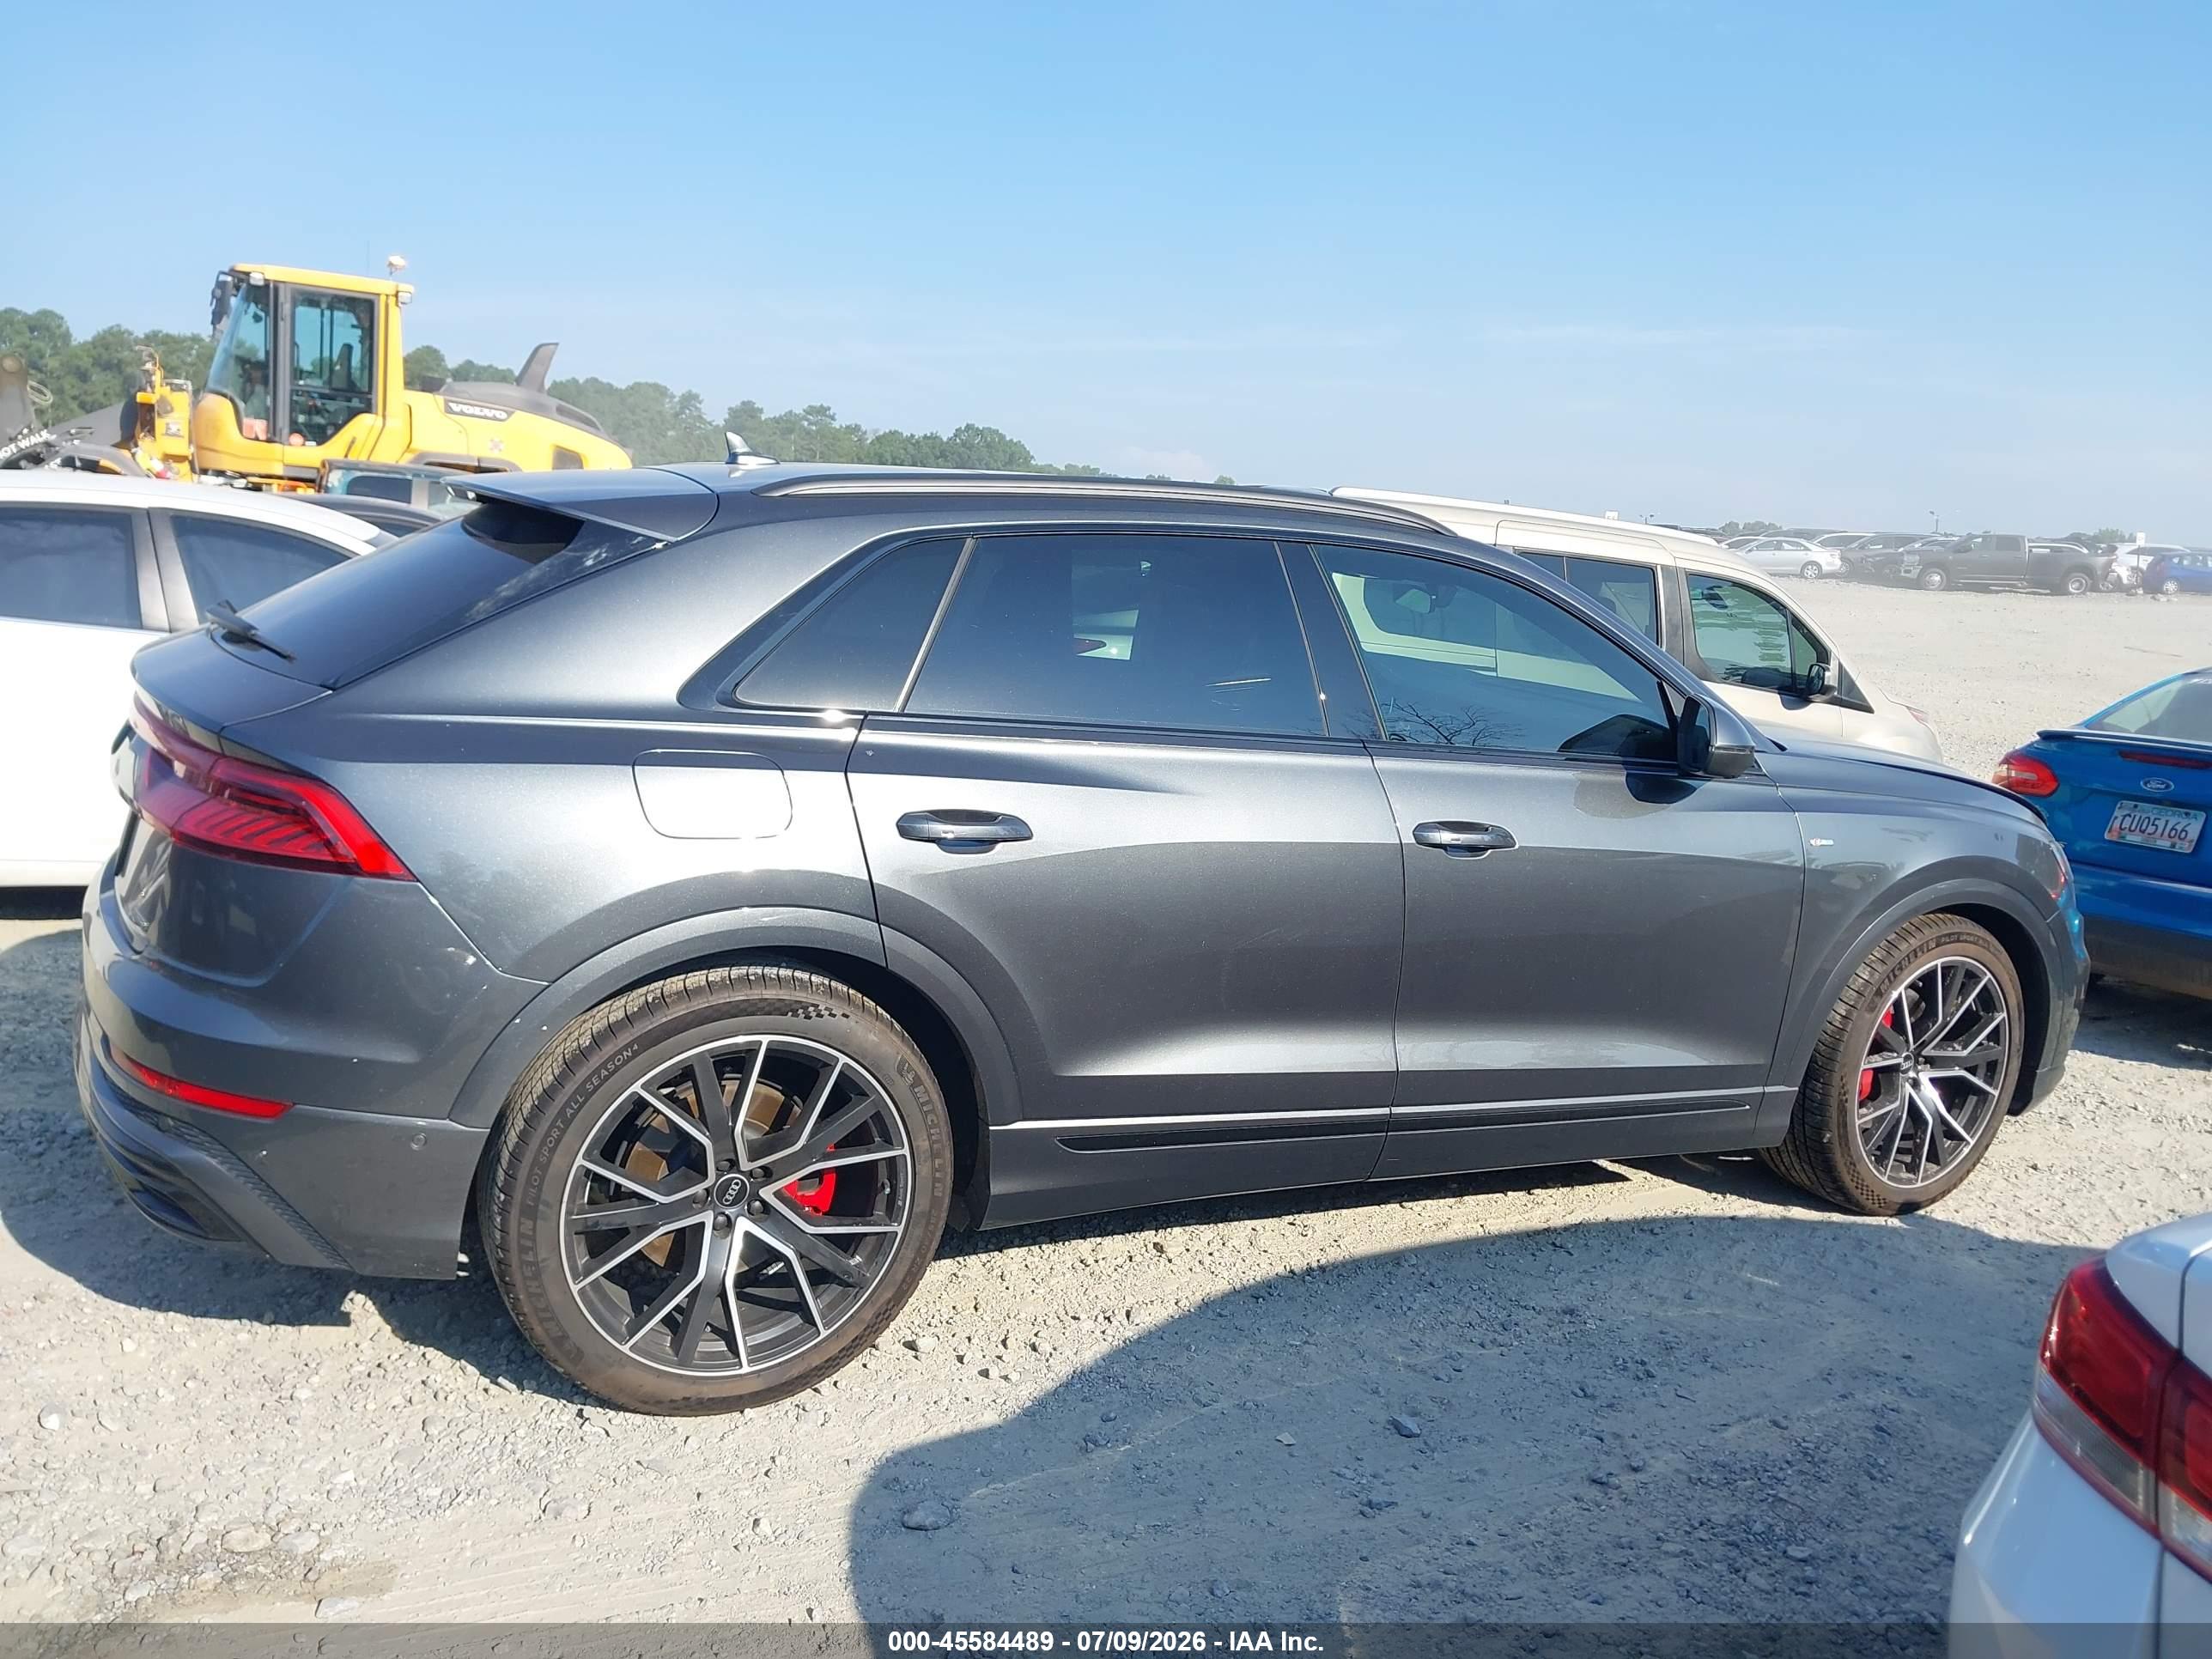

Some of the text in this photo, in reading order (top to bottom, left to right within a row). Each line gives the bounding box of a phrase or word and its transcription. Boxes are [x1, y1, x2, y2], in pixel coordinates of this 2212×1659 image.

[447, 401, 508, 420] VOLVO
[2118, 813, 2192, 841] CUQ5166
[565, 1094, 586, 1119] ALL
[540, 1119, 565, 1163] SPORT
[914, 1084, 943, 1197] MICHELIN
[527, 1167, 544, 1206] PILOT
[520, 1217, 563, 1338] MICHELIN
